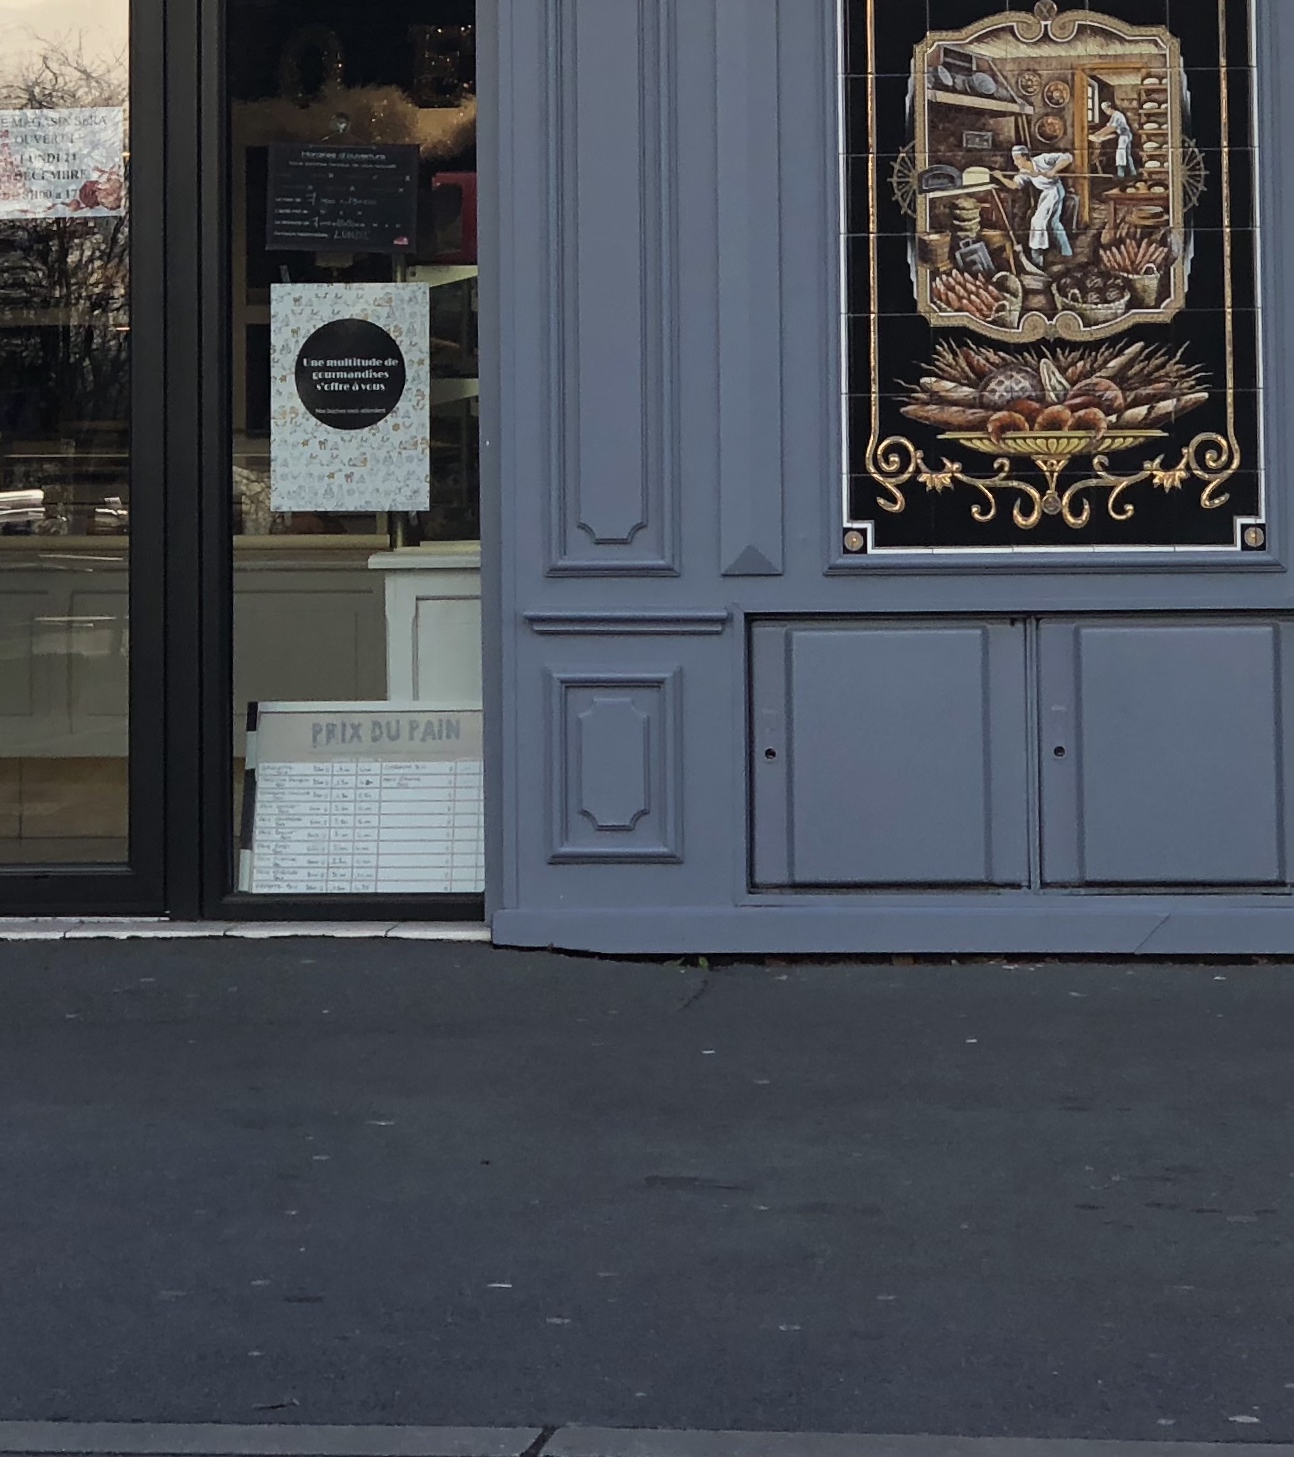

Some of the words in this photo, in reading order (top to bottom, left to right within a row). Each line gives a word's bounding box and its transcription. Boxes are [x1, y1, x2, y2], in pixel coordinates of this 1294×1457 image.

[302, 357, 325, 367] Une
[326, 357, 382, 367] multitude
[384, 357, 399, 367] de
[312, 369, 390, 381] gourmandises
[361, 383, 386, 392] vous
[311, 722, 363, 745] PRIX
[370, 720, 402, 743] DU
[407, 718, 462, 742] PAIN
